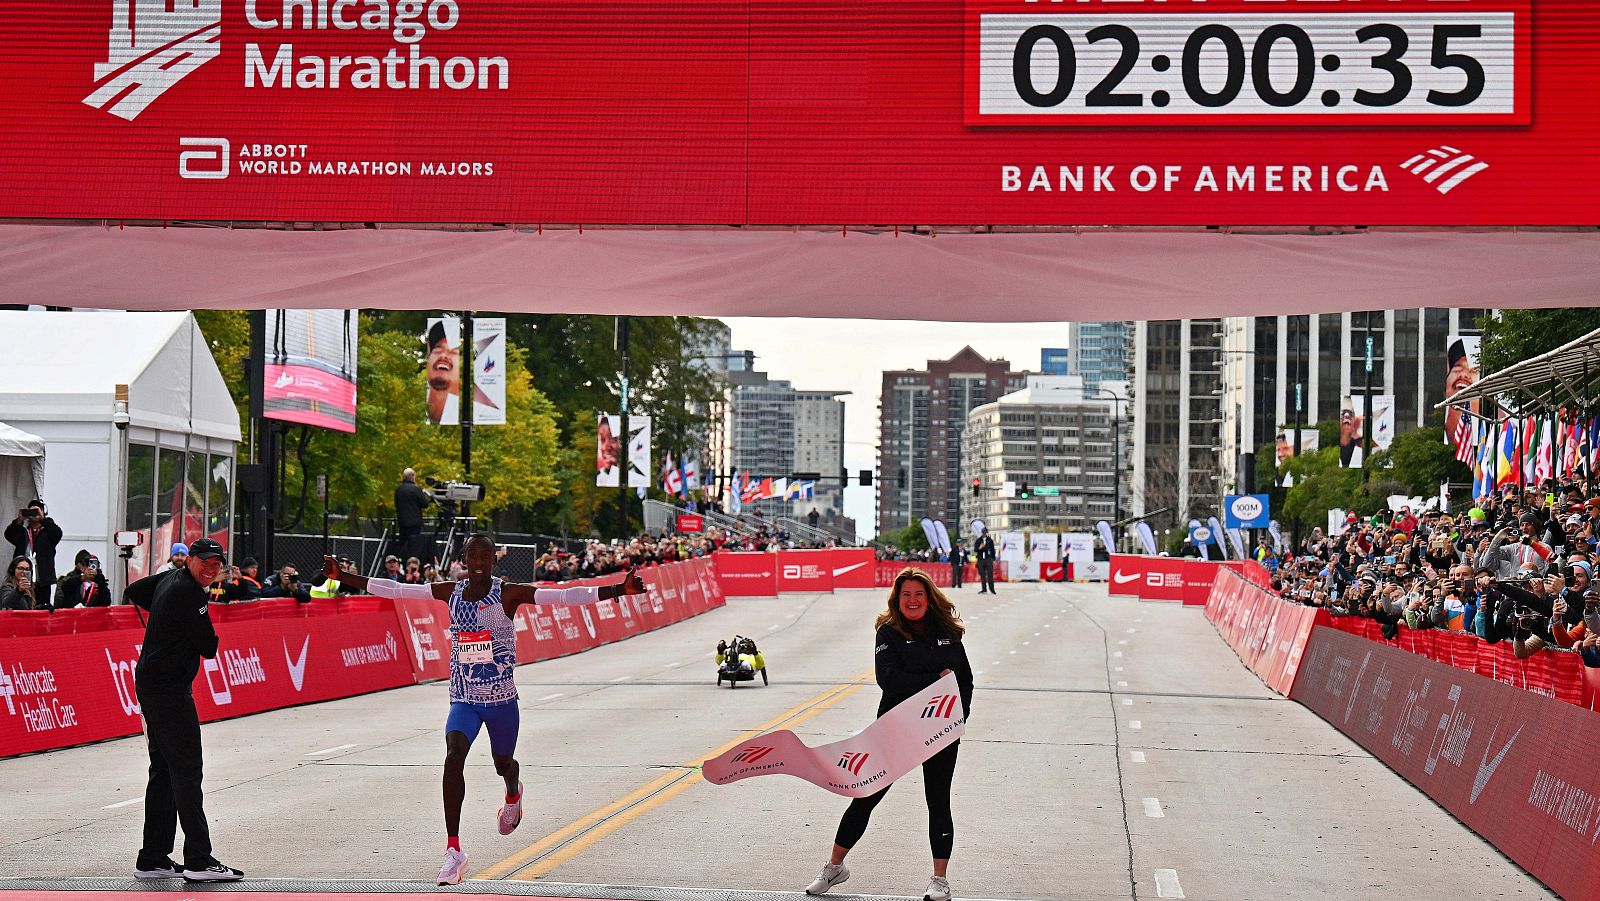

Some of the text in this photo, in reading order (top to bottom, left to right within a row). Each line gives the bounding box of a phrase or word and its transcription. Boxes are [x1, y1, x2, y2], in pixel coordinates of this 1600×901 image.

[244, 0, 460, 44] Chicago
[244, 43, 509, 90] Marathon
[1012, 23, 1486, 108] 02:00:35
[239, 144, 308, 158] ABBOTT
[239, 160, 494, 176] WORLD MARATHON MAJORS
[1001, 165, 1389, 192] BANK OF AMERICA
[340, 644, 391, 667] BANK OF AMERICA
[459, 643, 491, 653] KIPTUM
[11, 661, 57, 696] Advocate
[223, 647, 266, 687] Abbott
[20, 696, 78, 733] Health Care
[924, 730, 945, 747] BANK
[944, 724, 953, 733] OF
[750, 761, 785, 771] AMERICA
[828, 781, 849, 790] BANK
